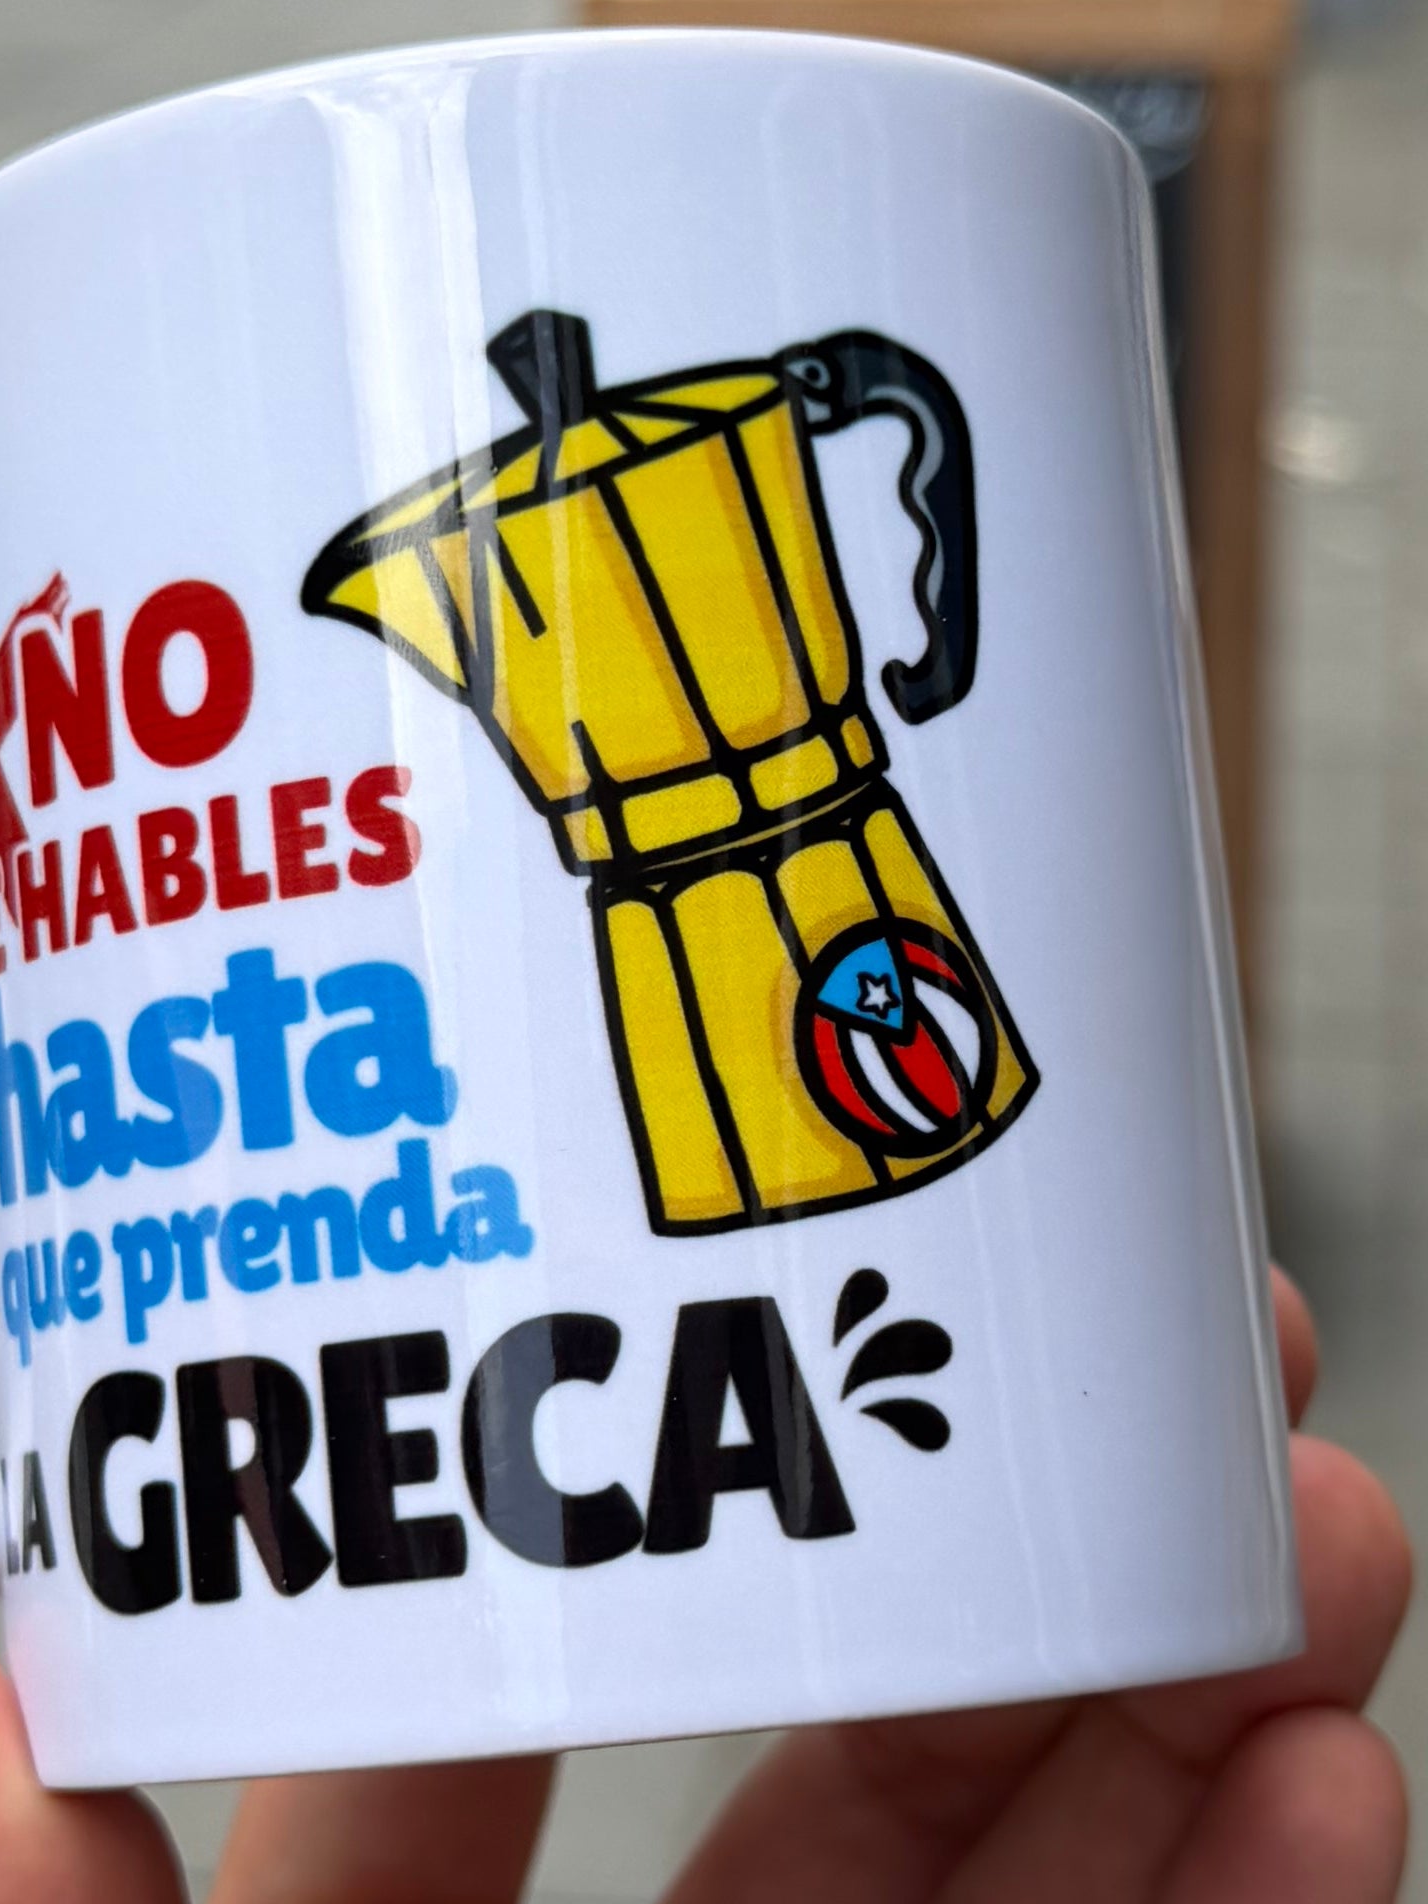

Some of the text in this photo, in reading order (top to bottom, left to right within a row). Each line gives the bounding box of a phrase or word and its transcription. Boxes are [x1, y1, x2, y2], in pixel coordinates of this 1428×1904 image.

[18, 579, 255, 809] NO
[15, 766, 422, 964] HABLES
[0, 1136, 538, 1370] que prenda
[67, 1295, 858, 1617] GRECA
